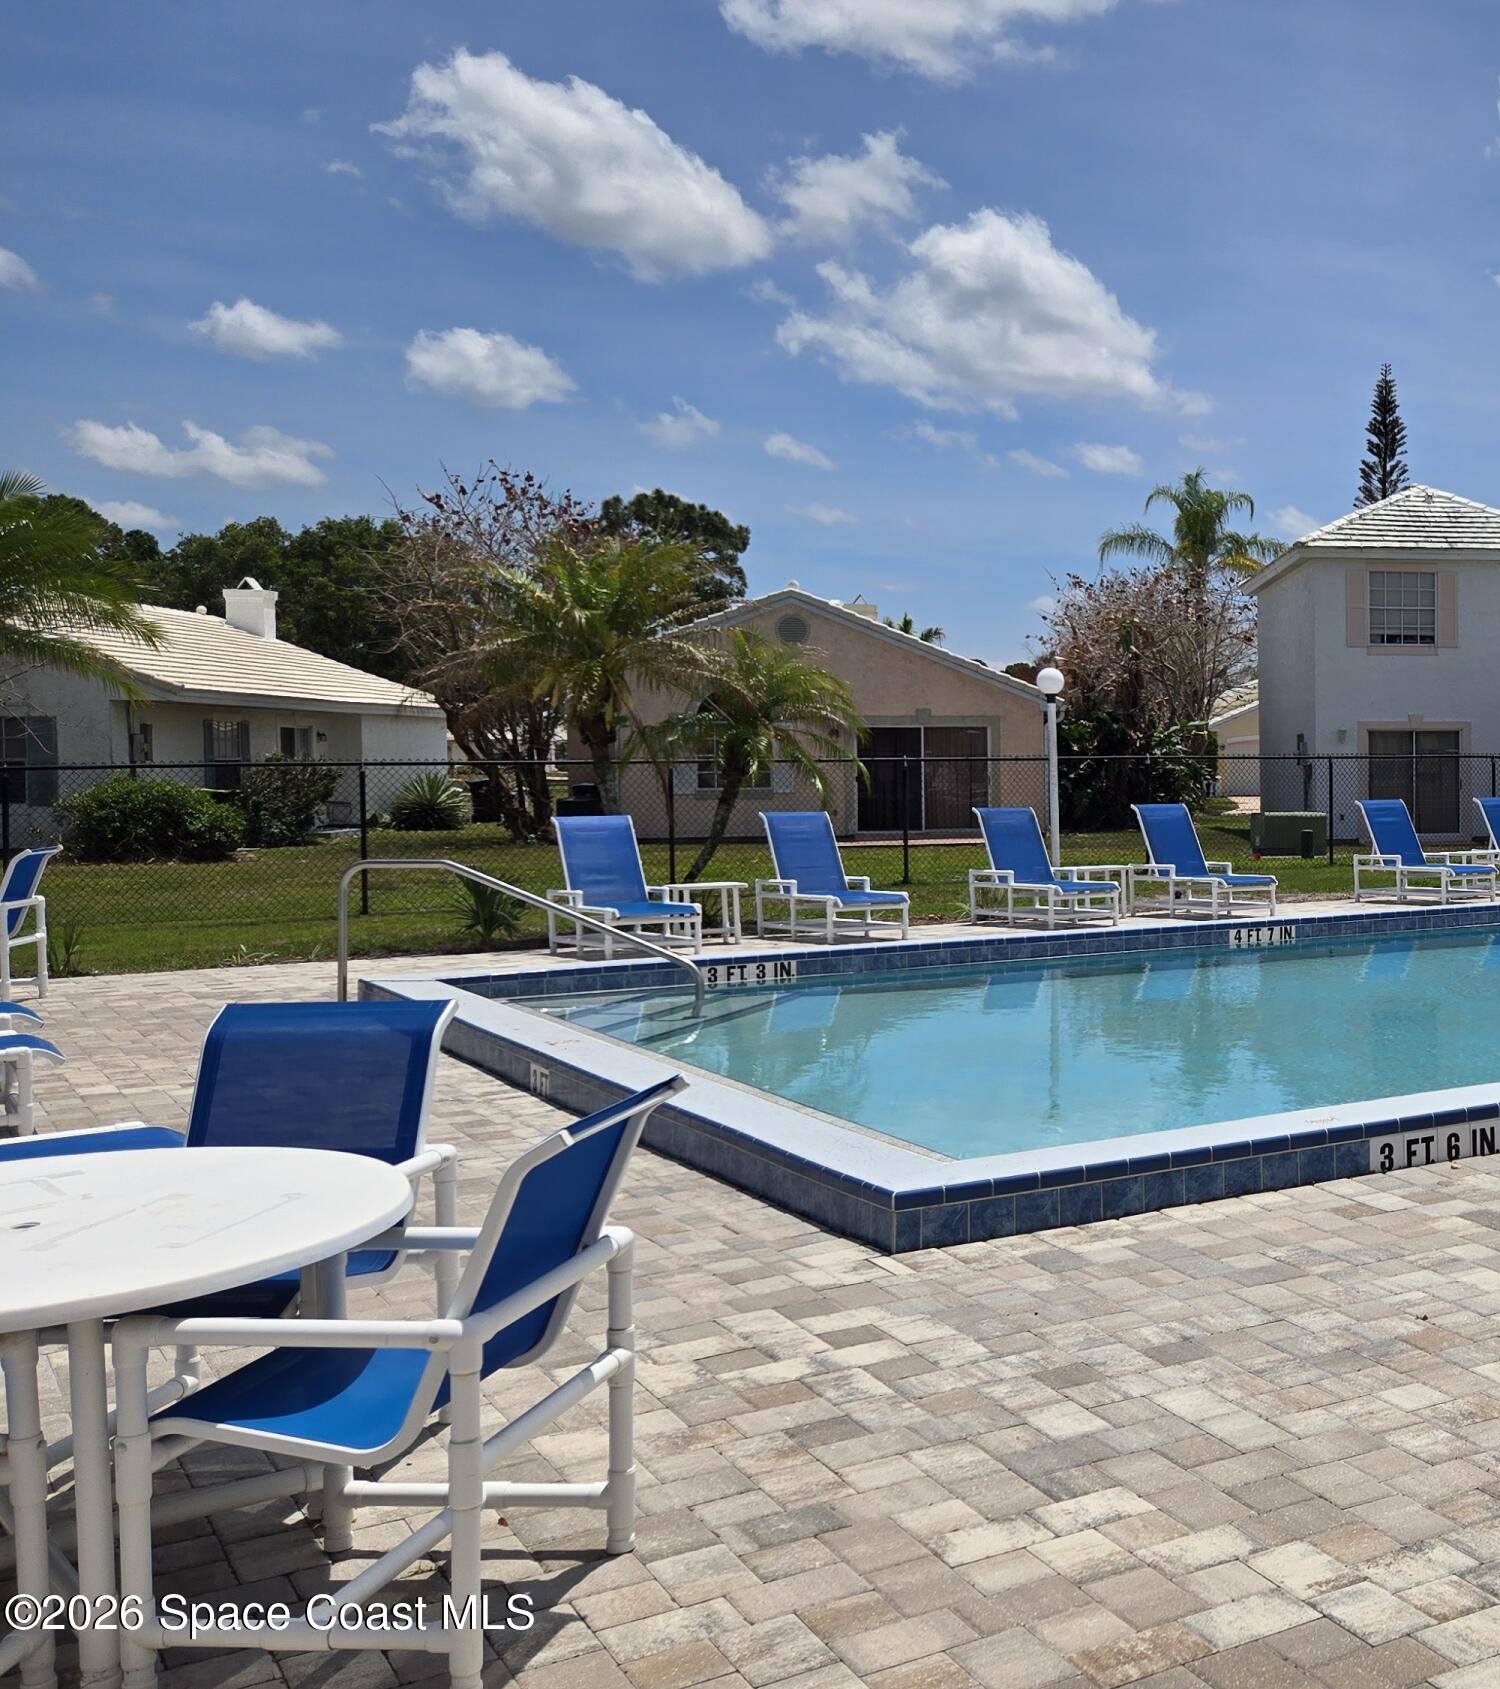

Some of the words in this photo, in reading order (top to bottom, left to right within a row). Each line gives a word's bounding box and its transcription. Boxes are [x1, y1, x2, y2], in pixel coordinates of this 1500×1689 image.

[1234, 929, 1243, 943] 4
[1267, 927, 1274, 941] 7
[707, 967, 718, 983] 3
[726, 965, 748, 982] FT.
[756, 963, 766, 979] 3
[774, 961, 795, 978] IN.
[1379, 1142, 1394, 1172] 3
[1406, 1135, 1435, 1167] FT.
[1446, 1132, 1460, 1160] 6
[1472, 1126, 1500, 1156] IN.
